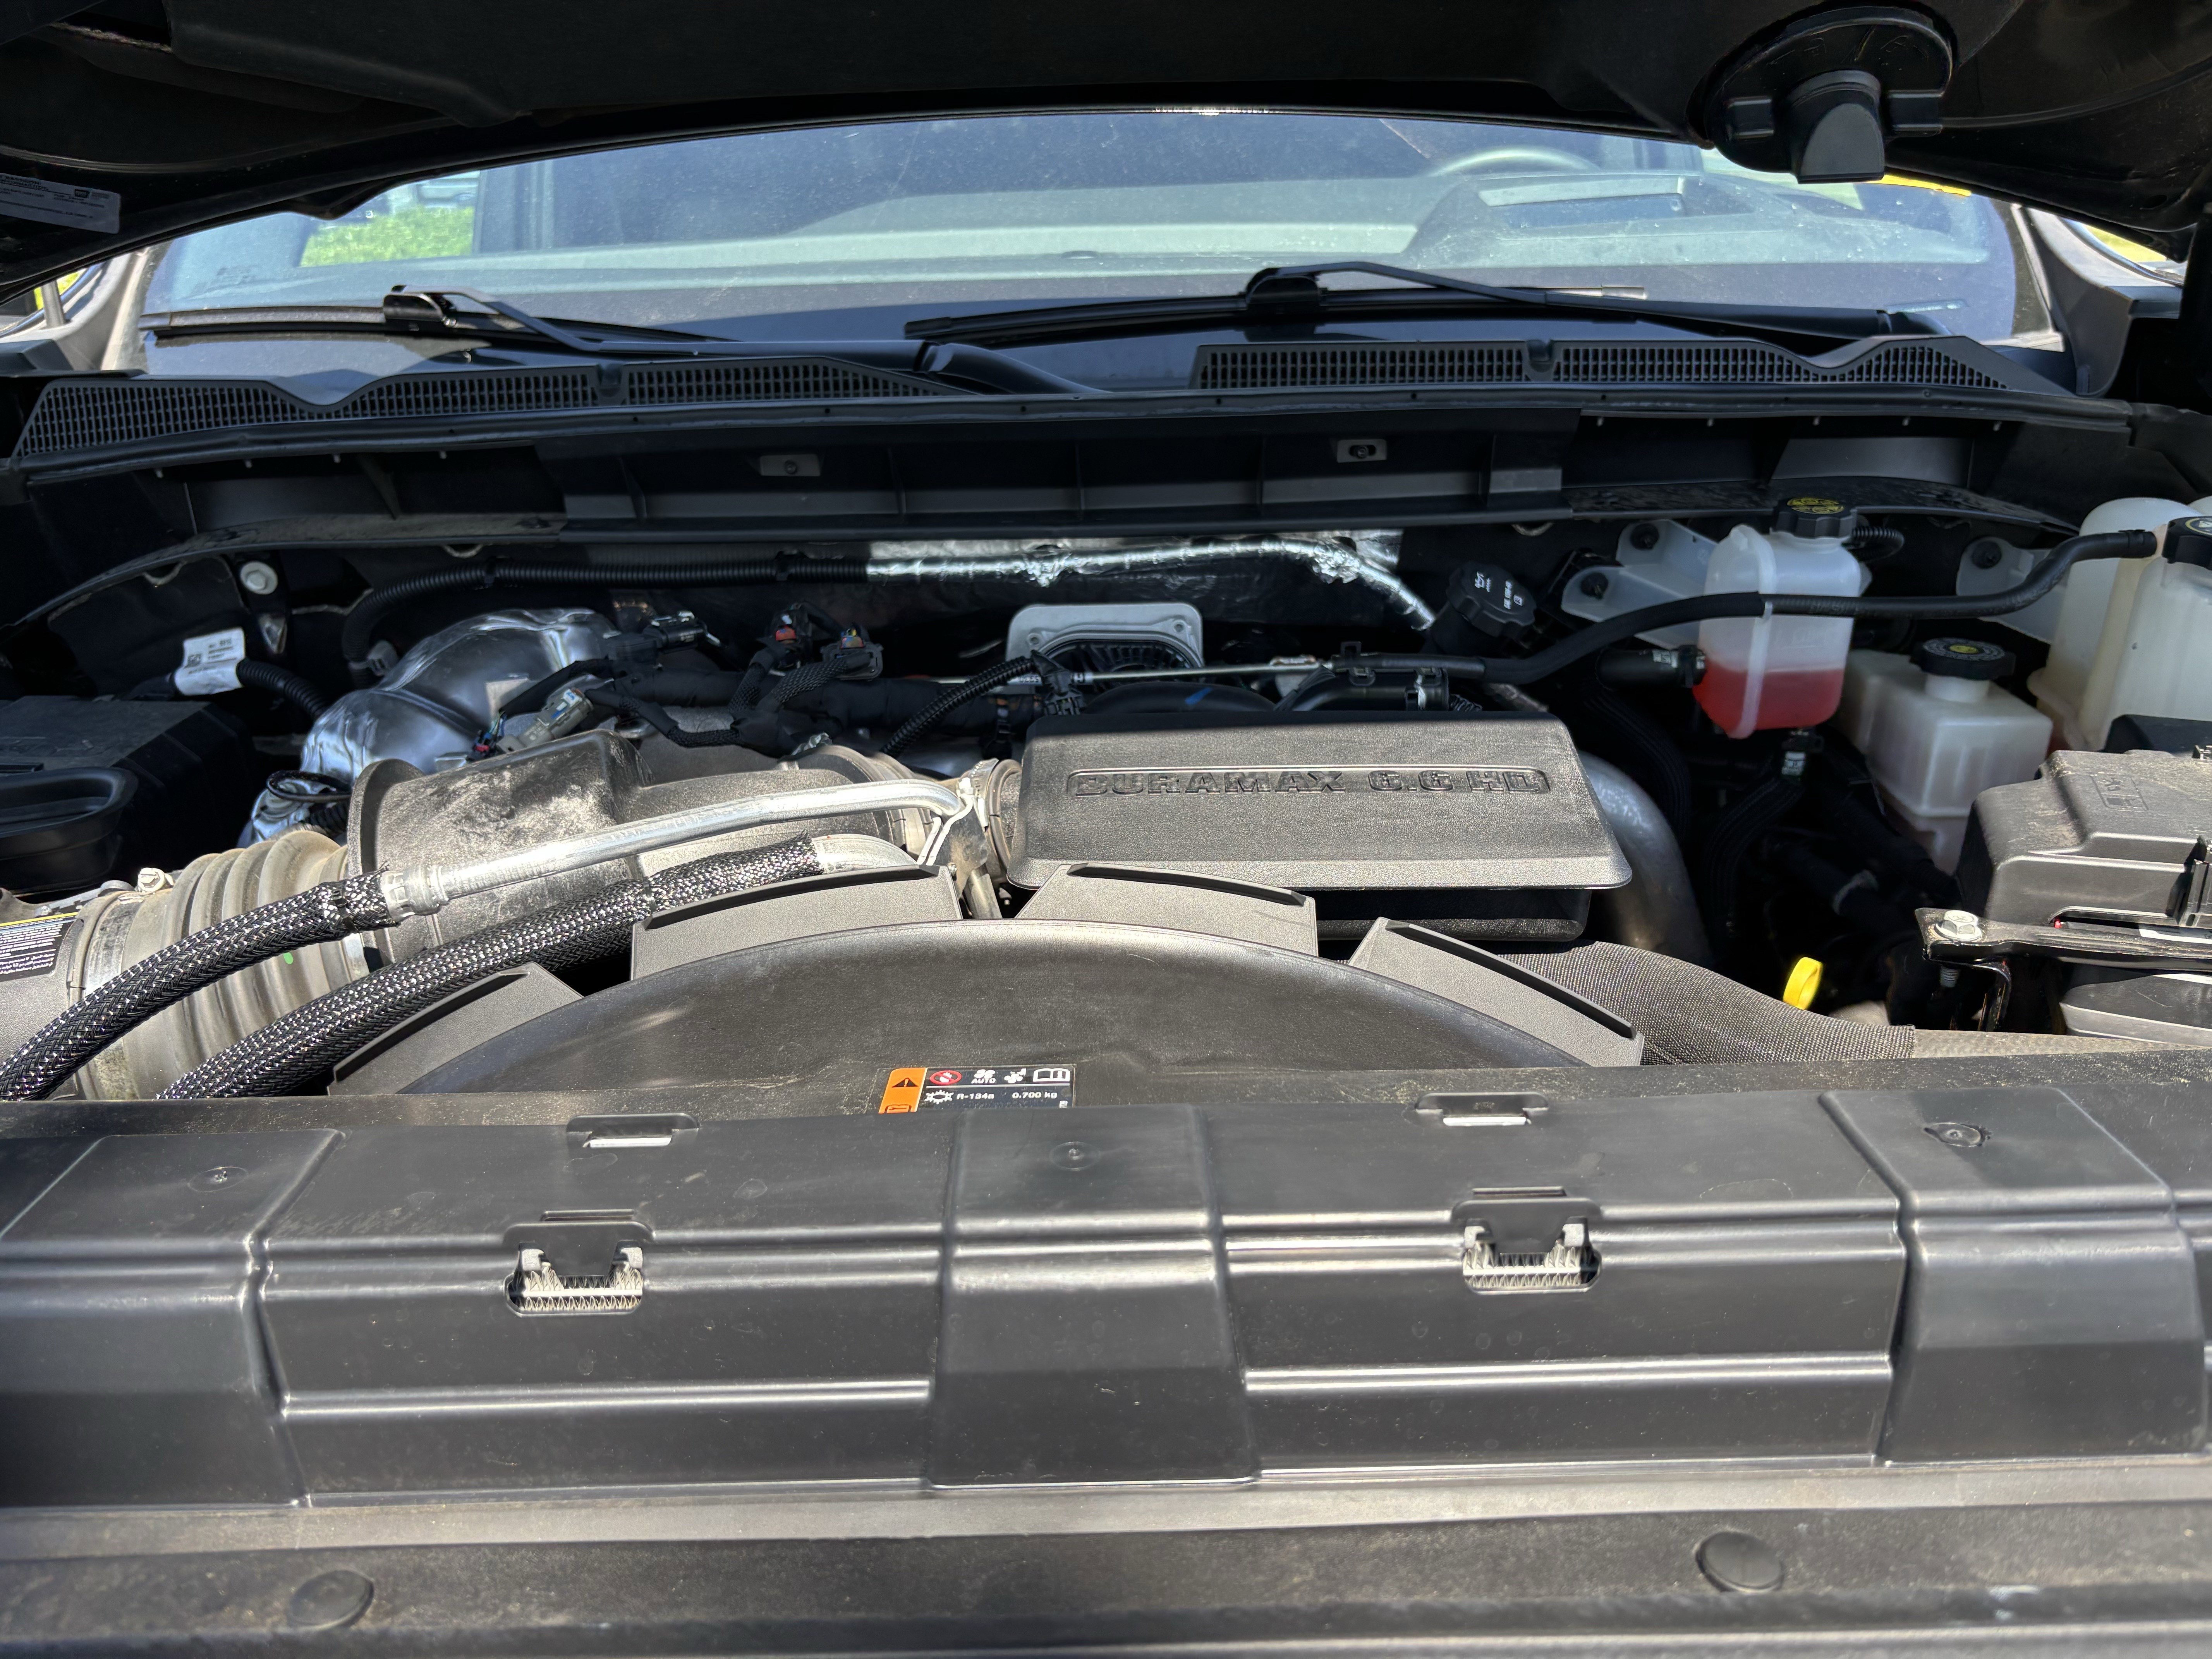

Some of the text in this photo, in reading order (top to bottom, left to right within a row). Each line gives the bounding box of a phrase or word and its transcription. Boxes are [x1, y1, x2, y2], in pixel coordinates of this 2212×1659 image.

[1075, 770, 1540, 796] DURAMAX 6.6 HD
